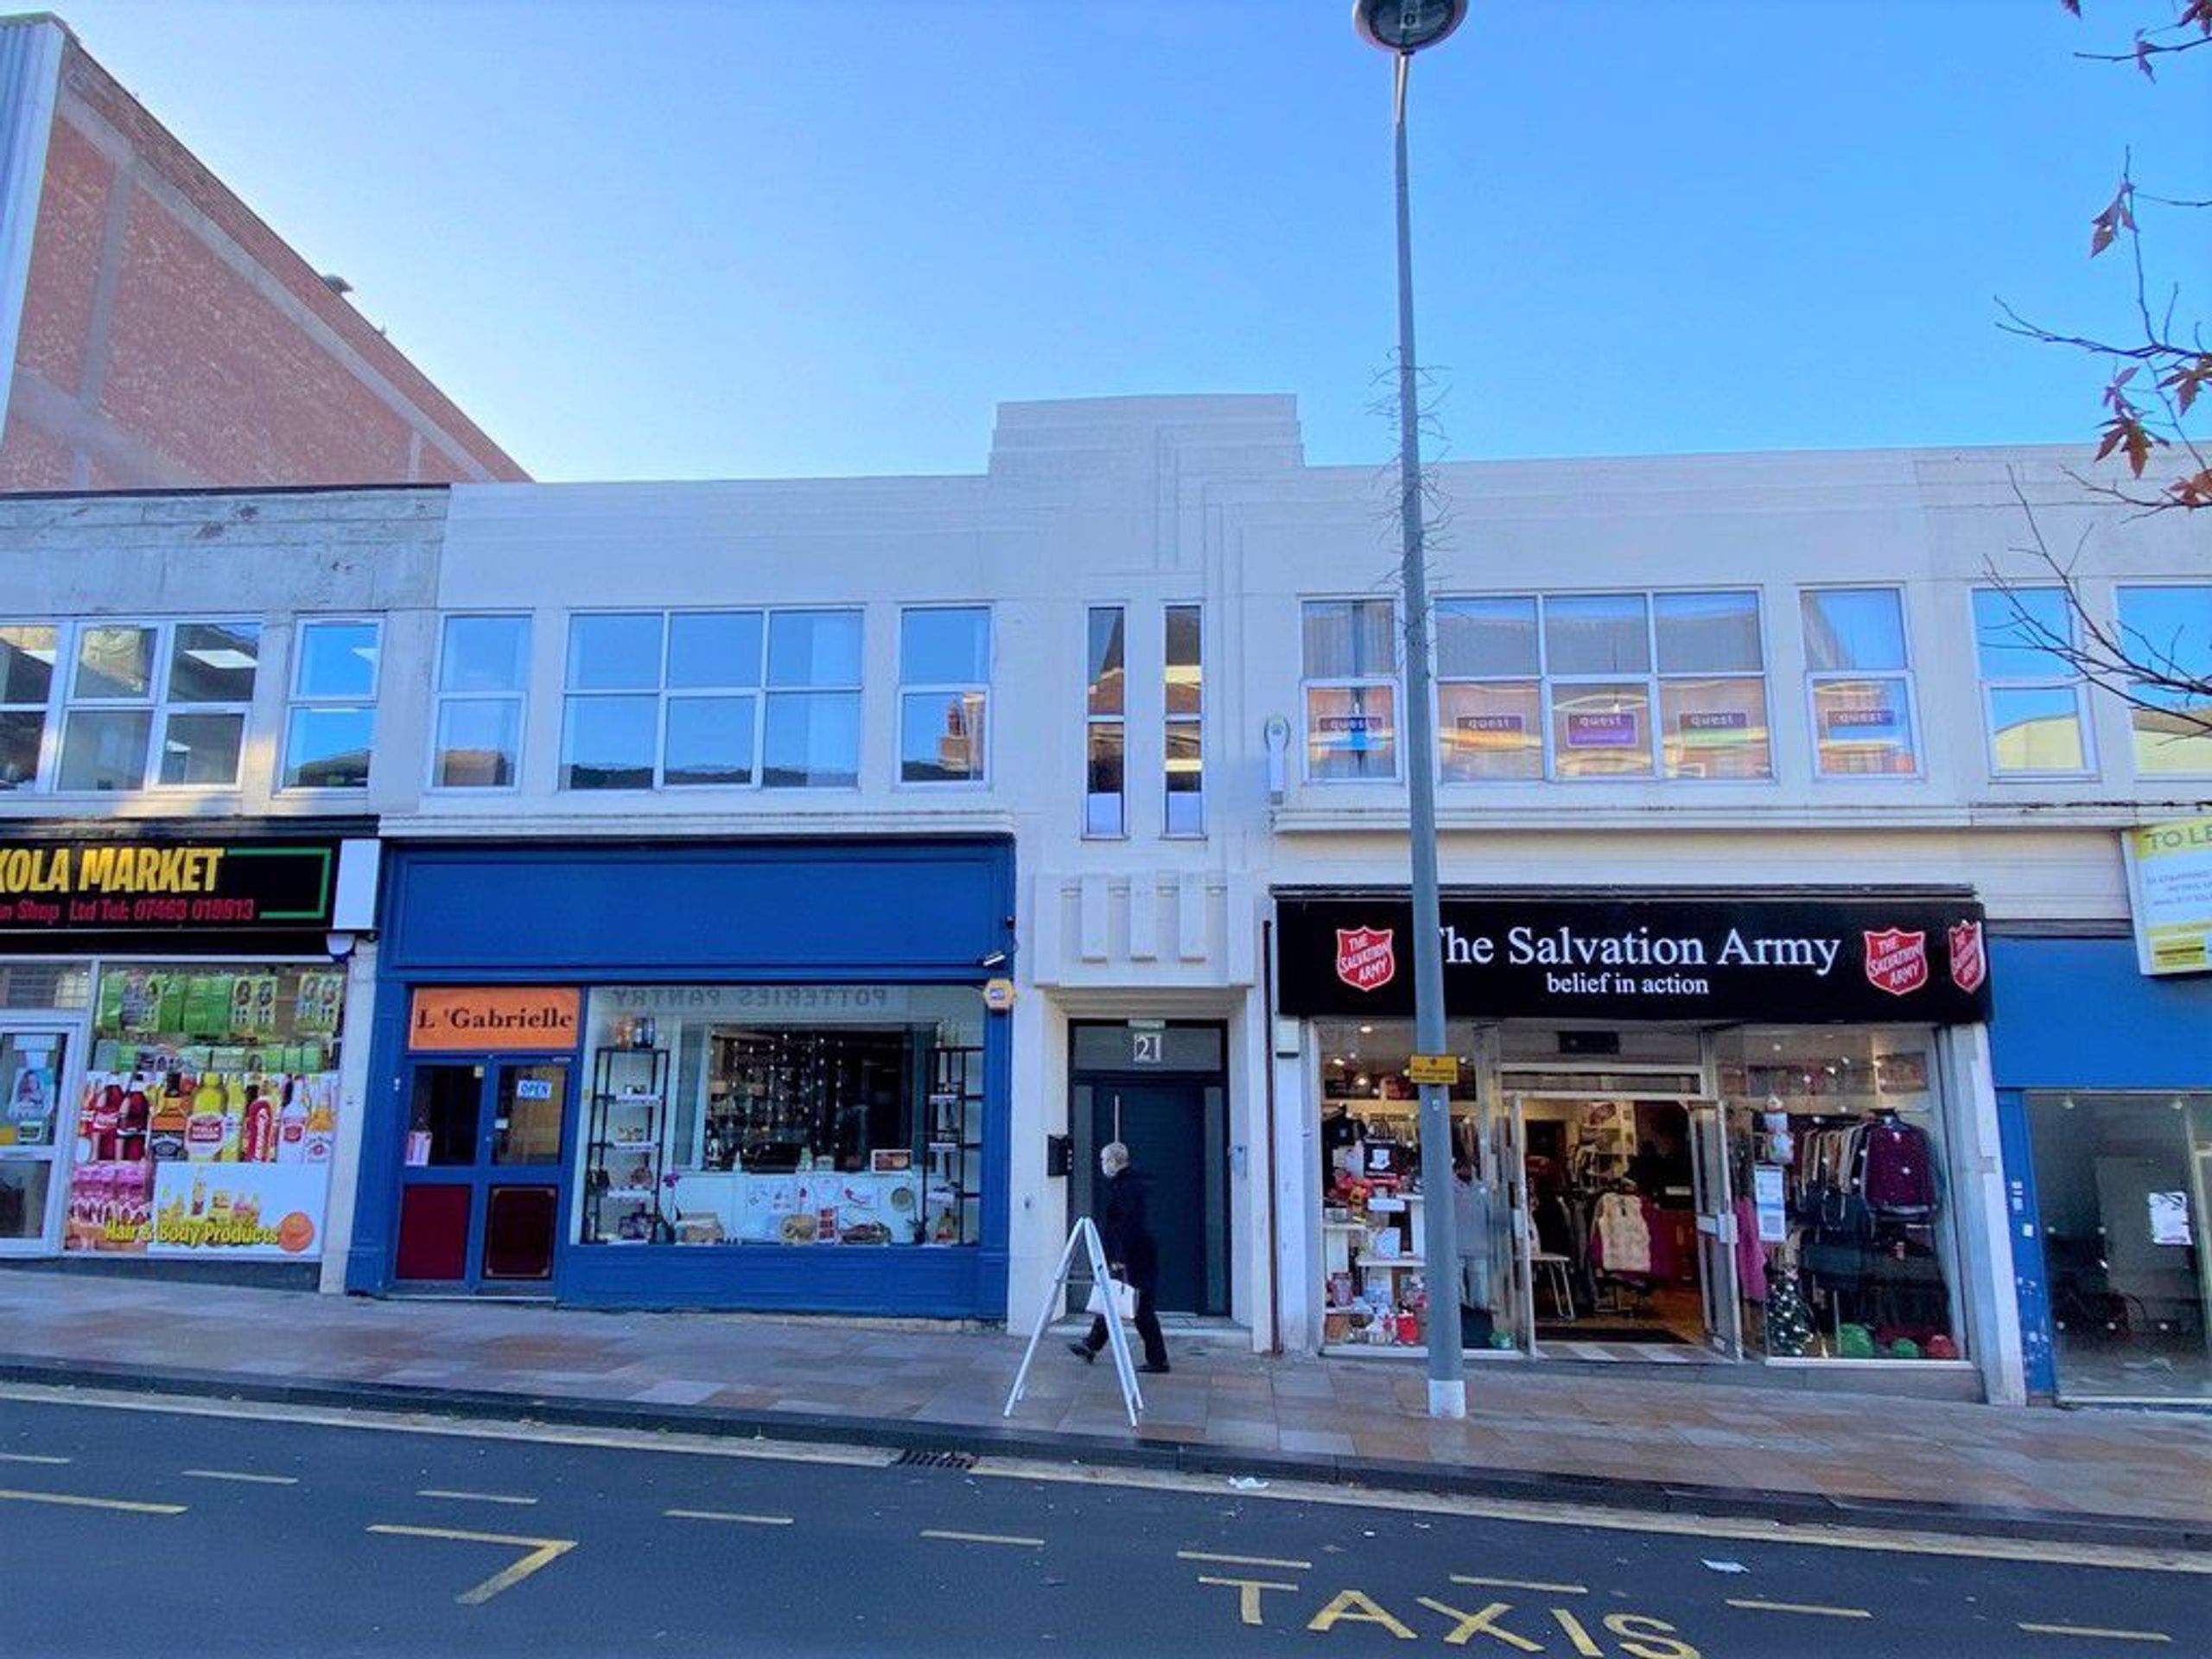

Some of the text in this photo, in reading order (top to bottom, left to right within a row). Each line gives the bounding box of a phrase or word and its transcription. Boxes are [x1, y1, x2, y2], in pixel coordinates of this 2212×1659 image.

[1579, 715, 1623, 728] quest
[1691, 715, 1735, 727] quest
[2145, 830, 2182, 849] TO
[78, 847, 225, 893] MARKET
[1439, 926, 1841, 976] he Salvation Army
[1546, 972, 1709, 994] belief in action
[520, 1083, 549, 1098] OPEN
[160, 1221, 200, 1245] Body
[1198, 1574, 1701, 1659] TAXIS
